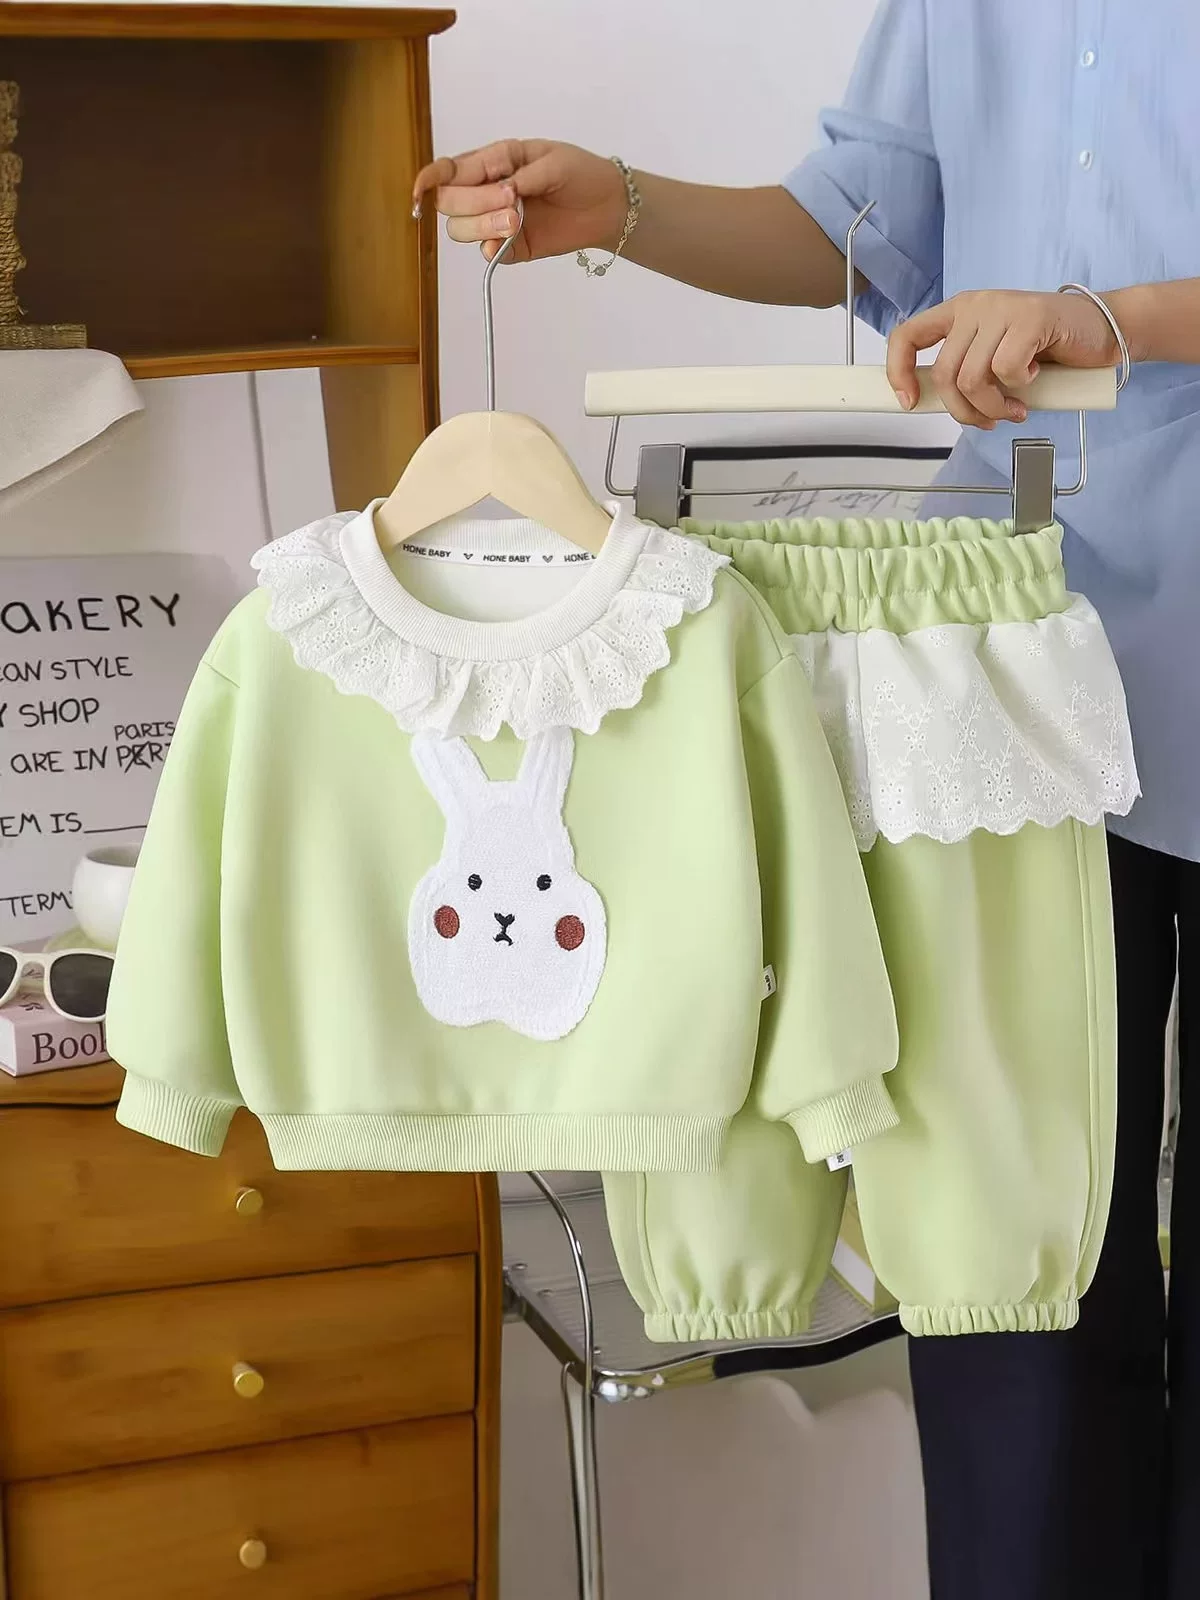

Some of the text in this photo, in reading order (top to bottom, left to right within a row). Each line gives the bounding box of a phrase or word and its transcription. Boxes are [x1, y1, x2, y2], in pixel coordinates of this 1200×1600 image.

[402, 543, 451, 558] HONE BABY
[483, 554, 531, 563] HONE BABY
[563, 553, 590, 562] HONE
[50, 656, 133, 680] STYLE
[19, 697, 100, 728] SHOP
[73, 746, 108, 771] IN
[0, 812, 82, 837] EM IS
